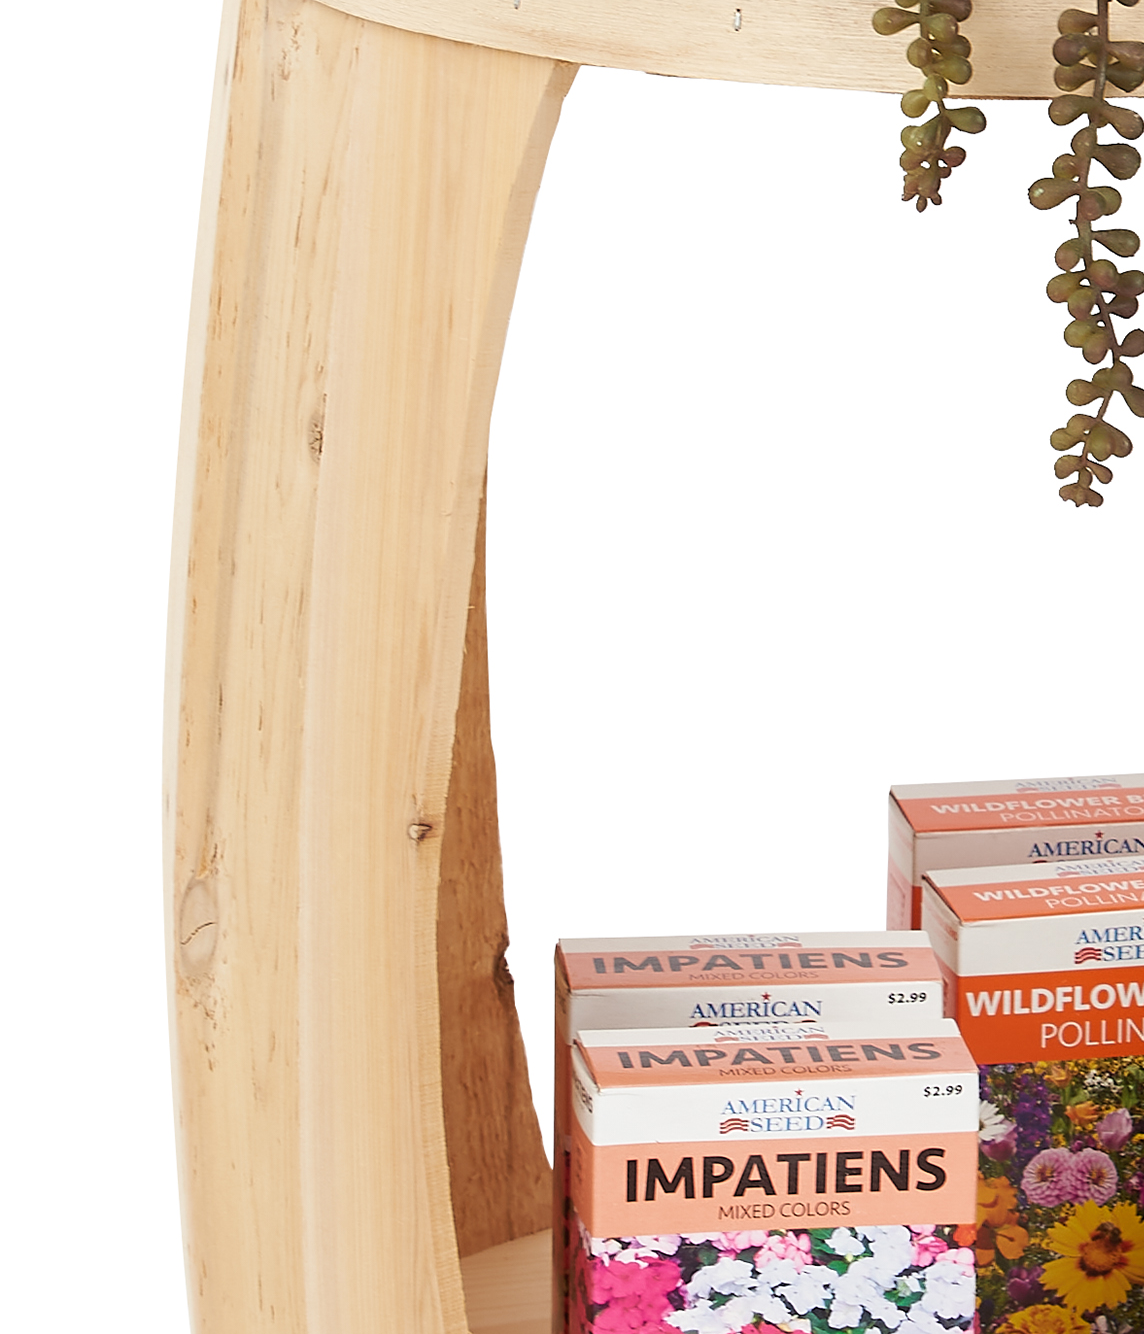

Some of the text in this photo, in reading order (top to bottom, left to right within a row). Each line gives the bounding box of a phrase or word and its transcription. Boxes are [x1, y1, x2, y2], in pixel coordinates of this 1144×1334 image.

[931, 794, 1120, 814] WILDFLOWER
[689, 936, 799, 944] AMERICAN
[592, 951, 909, 974] IMPATIENS
[689, 971, 819, 981] MIXED COLORS
[888, 991, 927, 1005] $2.99
[690, 996, 822, 1019] AMERICAN
[713, 1027, 826, 1038] AMERICAN
[617, 1042, 943, 1070] IMPATIENS
[719, 1064, 853, 1077] MIXED COLORS
[923, 1084, 963, 1099] $2.99
[720, 1093, 856, 1116] AMERICAN
[750, 1115, 825, 1133] SEED
[626, 1147, 947, 1203] IMPATIENS
[718, 1201, 852, 1220] MIXED COLORS
